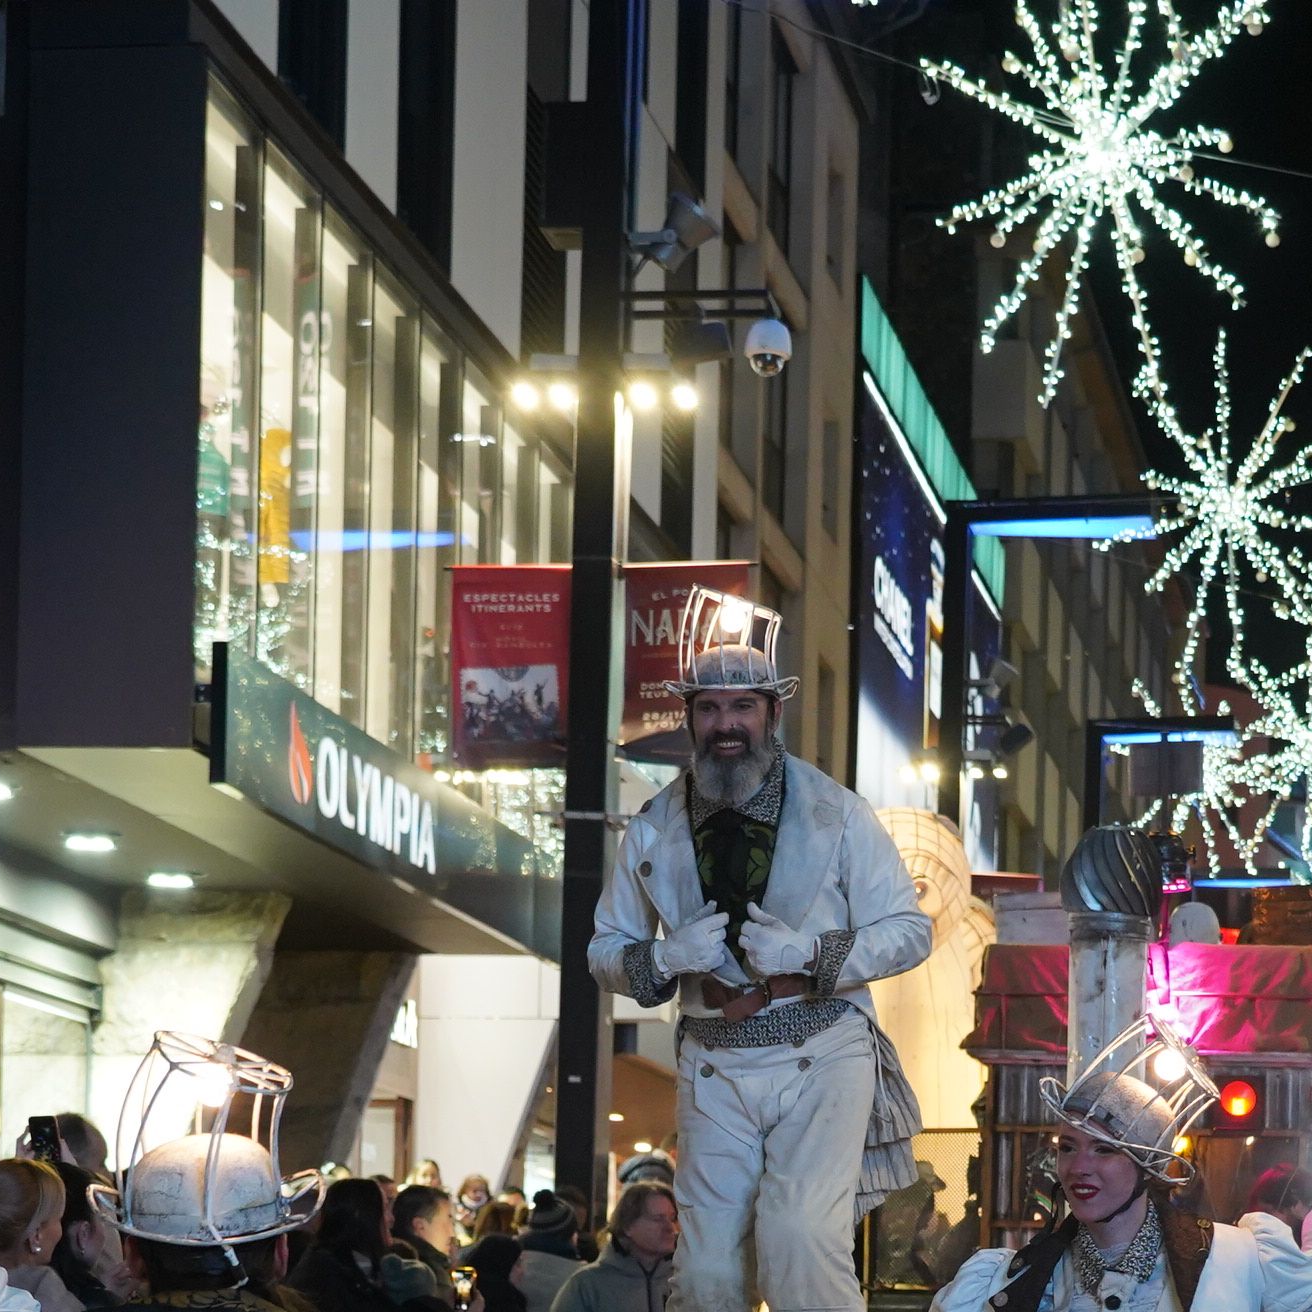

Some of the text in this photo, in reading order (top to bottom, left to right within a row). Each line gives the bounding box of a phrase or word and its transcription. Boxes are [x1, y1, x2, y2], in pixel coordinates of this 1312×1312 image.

[462, 593, 561, 603] ESPECTACLES
[471, 603, 552, 614] ITINERANTS
[873, 556, 914, 657] CHANEL
[316, 736, 437, 876] OLYMPIA
